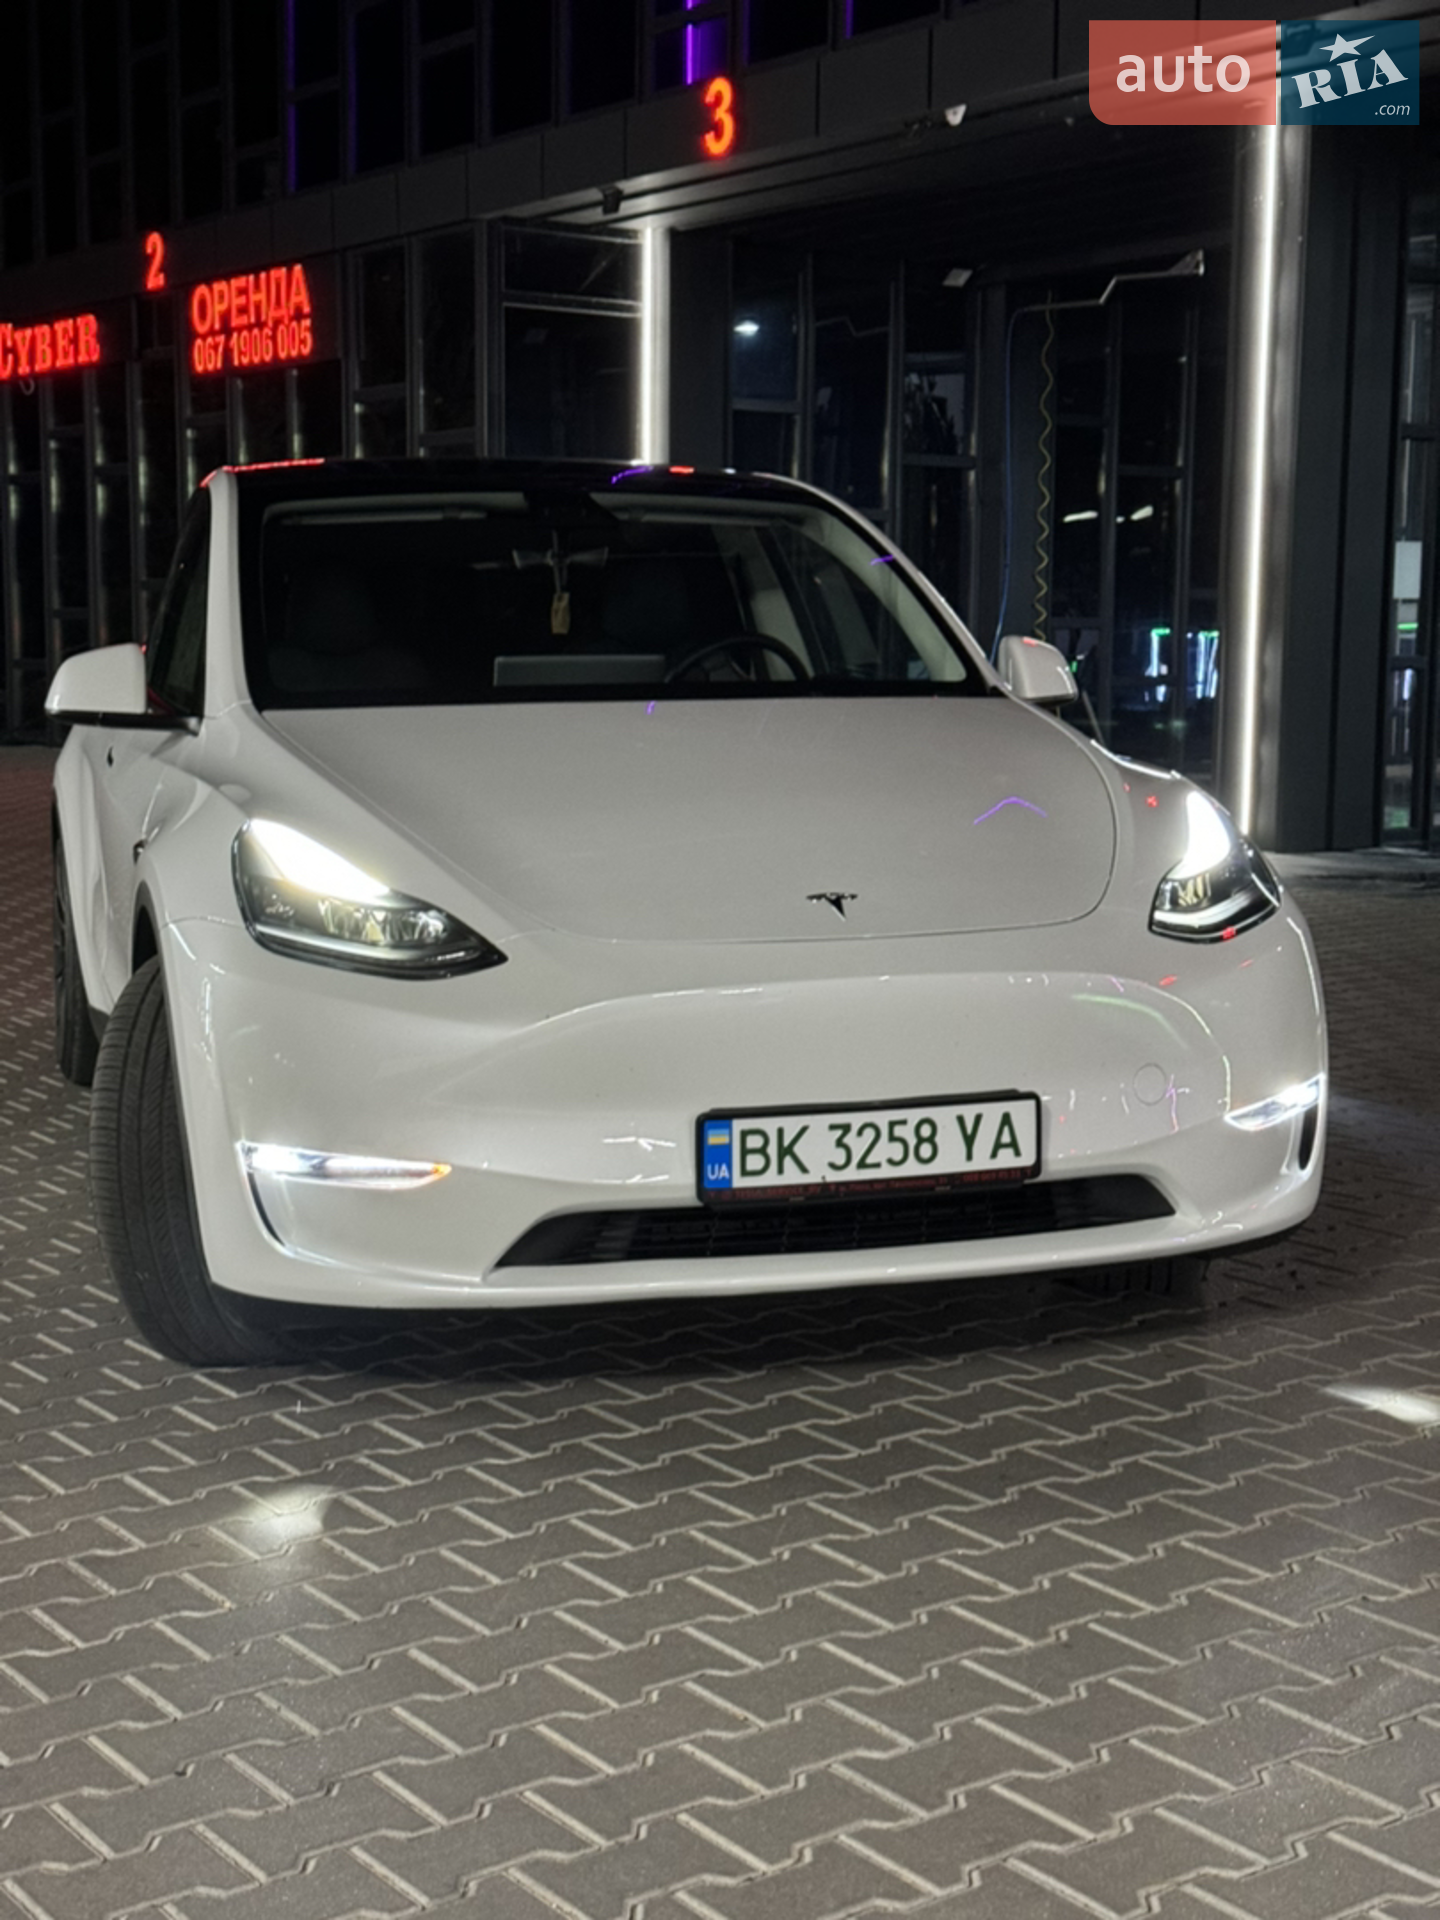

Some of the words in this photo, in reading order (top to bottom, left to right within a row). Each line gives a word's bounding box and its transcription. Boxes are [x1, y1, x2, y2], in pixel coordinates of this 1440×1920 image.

[704, 76, 734, 156] 3
[146, 231, 166, 291] 2
[191, 263, 311, 336] ОРЕНДА
[193, 333, 226, 374] 067
[228, 326, 273, 367] 1906
[276, 317, 313, 360] 005
[707, 1163, 730, 1181] UA
[739, 1124, 811, 1178] BK
[826, 1116, 940, 1173] 3258
[956, 1110, 1023, 1163] YA
